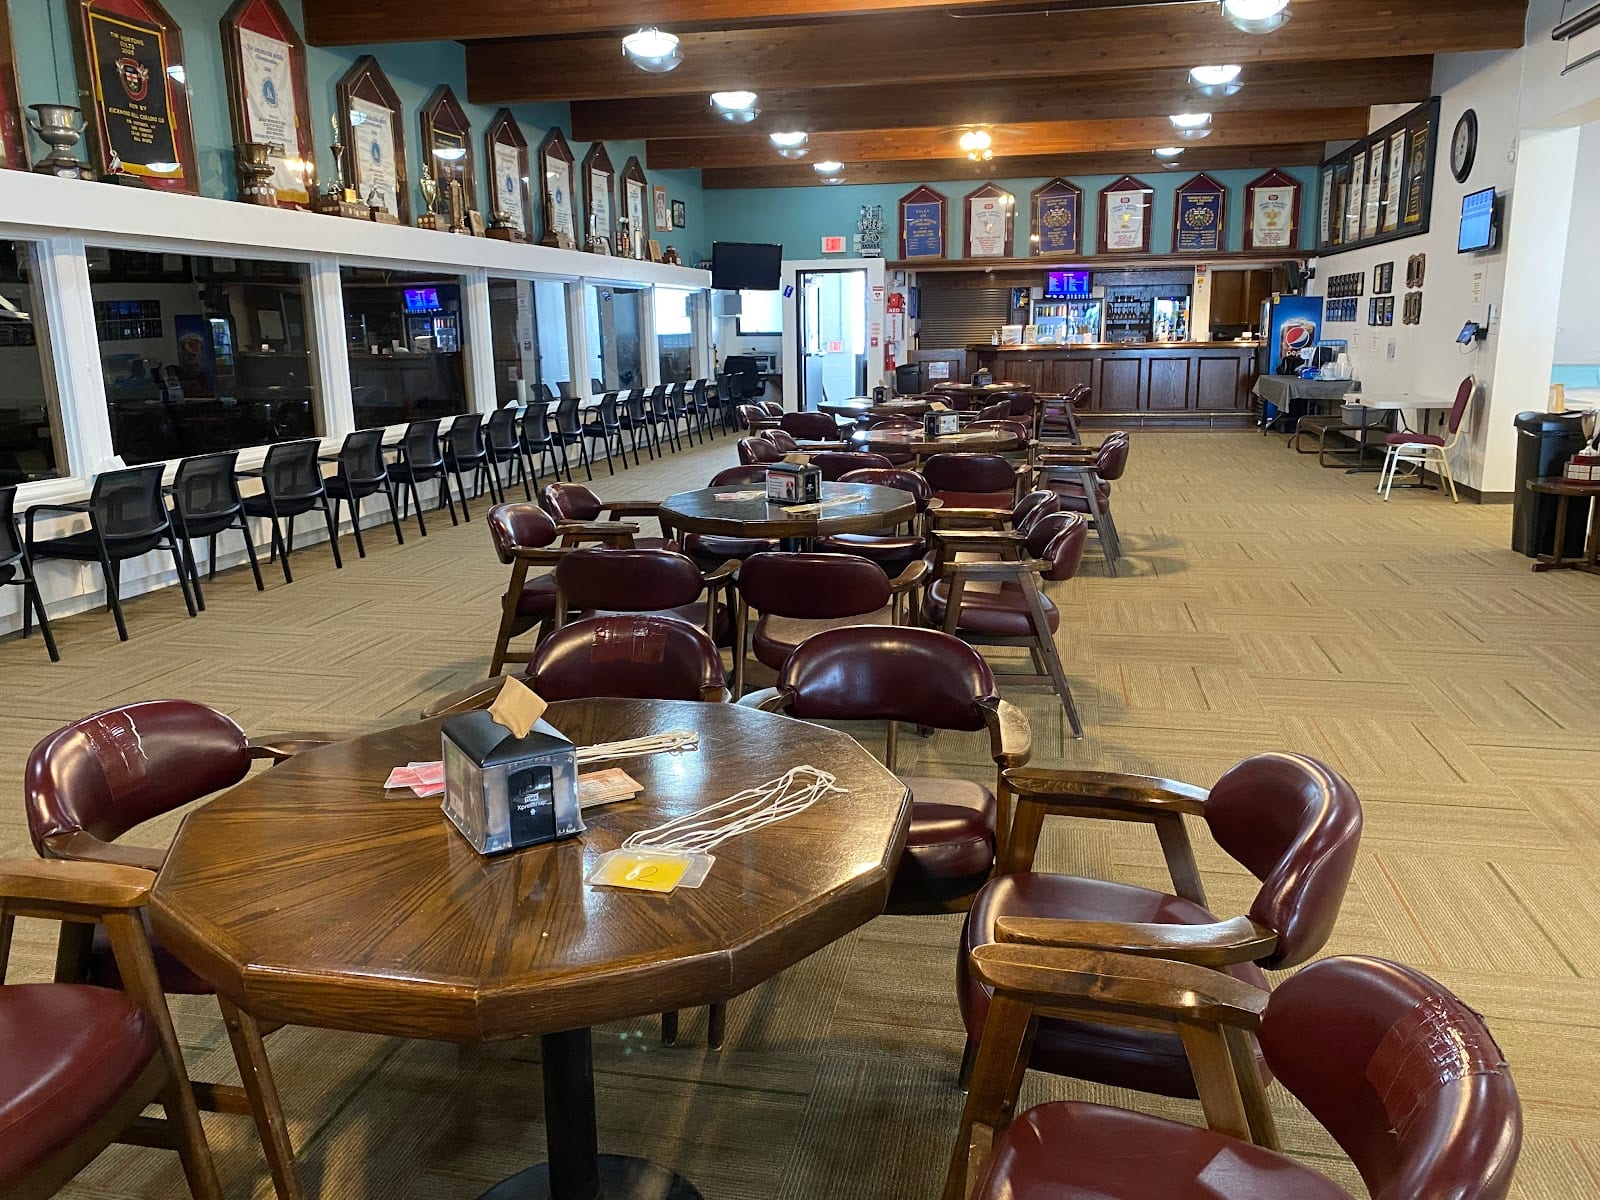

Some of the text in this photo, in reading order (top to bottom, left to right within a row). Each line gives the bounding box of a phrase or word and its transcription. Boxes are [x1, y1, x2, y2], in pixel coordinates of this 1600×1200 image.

[825, 238, 841, 251] EXIT
[830, 342, 842, 352] EXIT
[637, 866, 658, 883] 2
